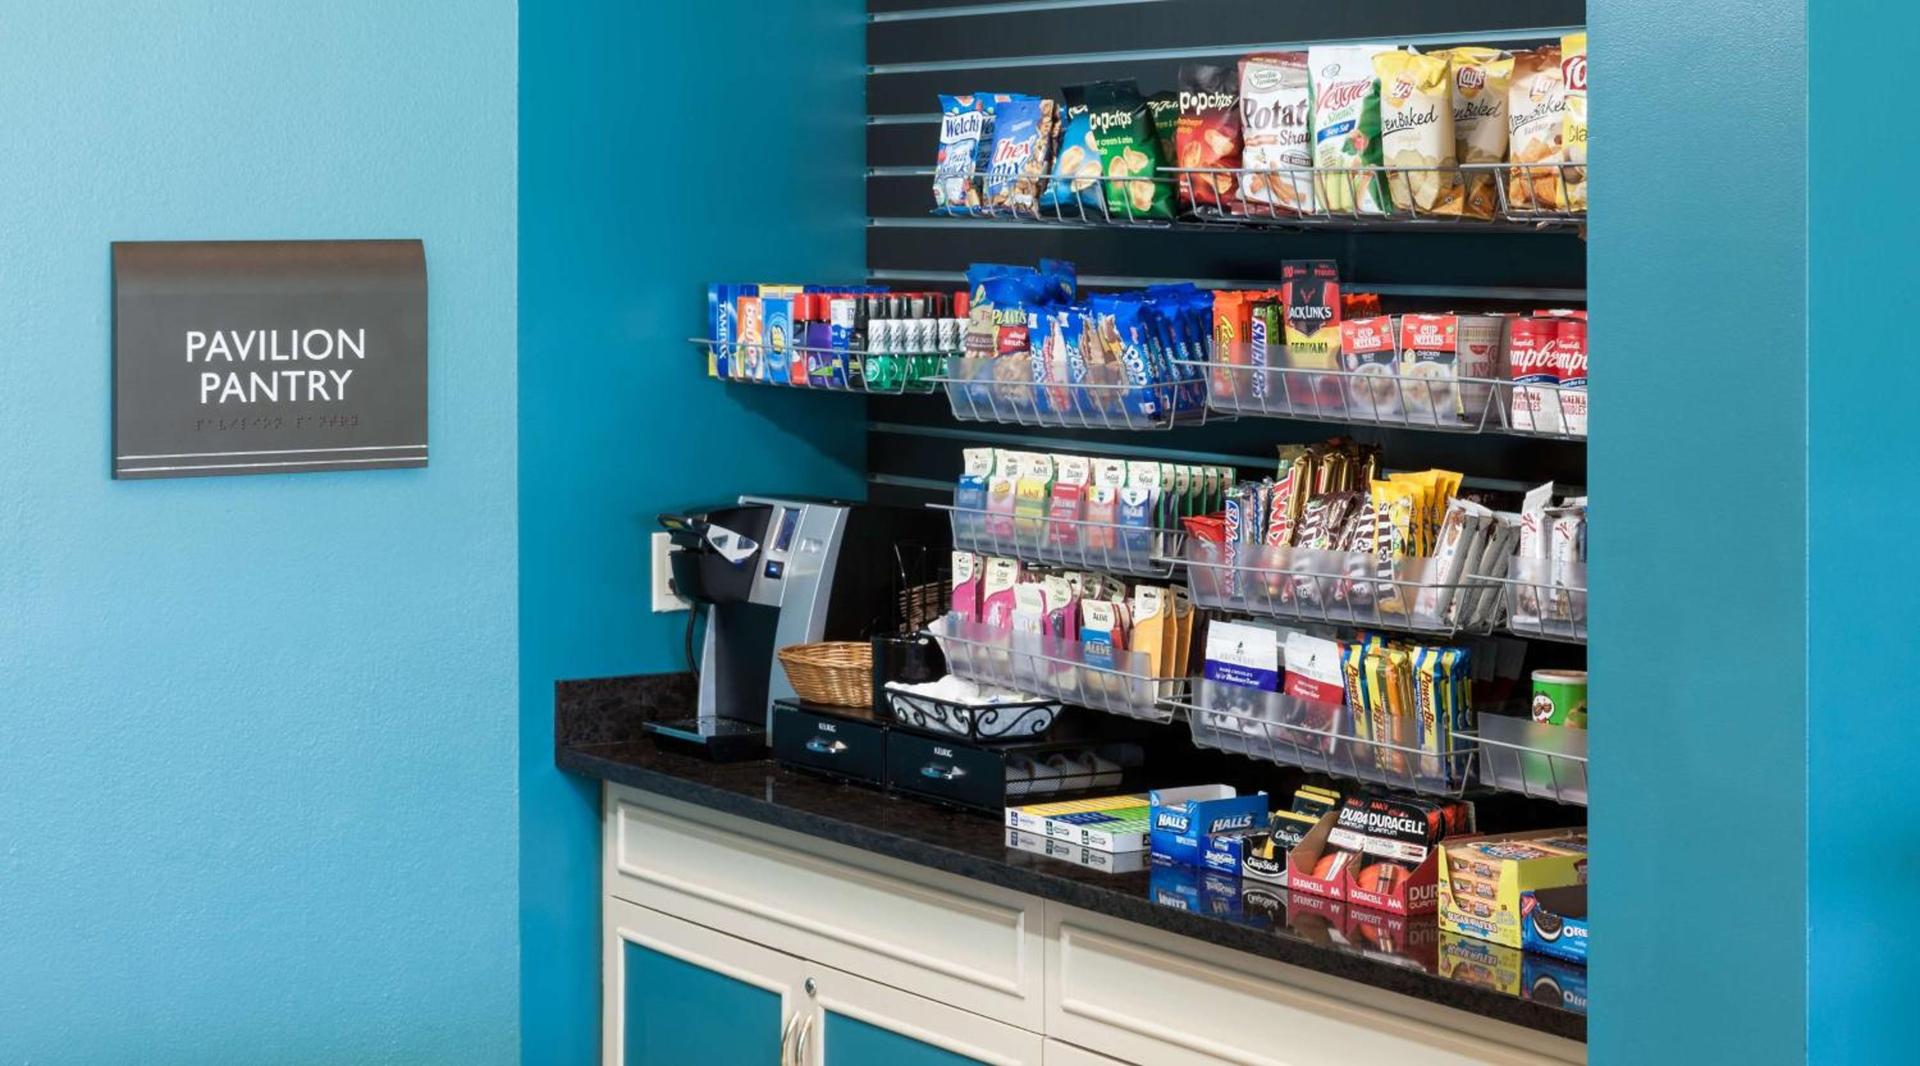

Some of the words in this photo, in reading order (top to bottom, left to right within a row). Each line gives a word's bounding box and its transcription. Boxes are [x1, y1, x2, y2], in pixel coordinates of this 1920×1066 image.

[1243, 98, 1310, 129] Potat
[186, 328, 366, 362] PAVILION
[199, 369, 354, 404] PANTRY
[1421, 669, 1435, 736] PowerBar
[1157, 813, 1189, 830] HALLS
[1212, 815, 1252, 833] HALLS
[1368, 826, 1398, 837] QUANTUM
[1369, 811, 1425, 835] DURACELL
[1247, 856, 1279, 872] ChapStick
[1292, 878, 1324, 893] DURACELL
[1330, 887, 1341, 897] AA
[1351, 889, 1383, 906] DURACELL
[1387, 898, 1403, 910] AAA
